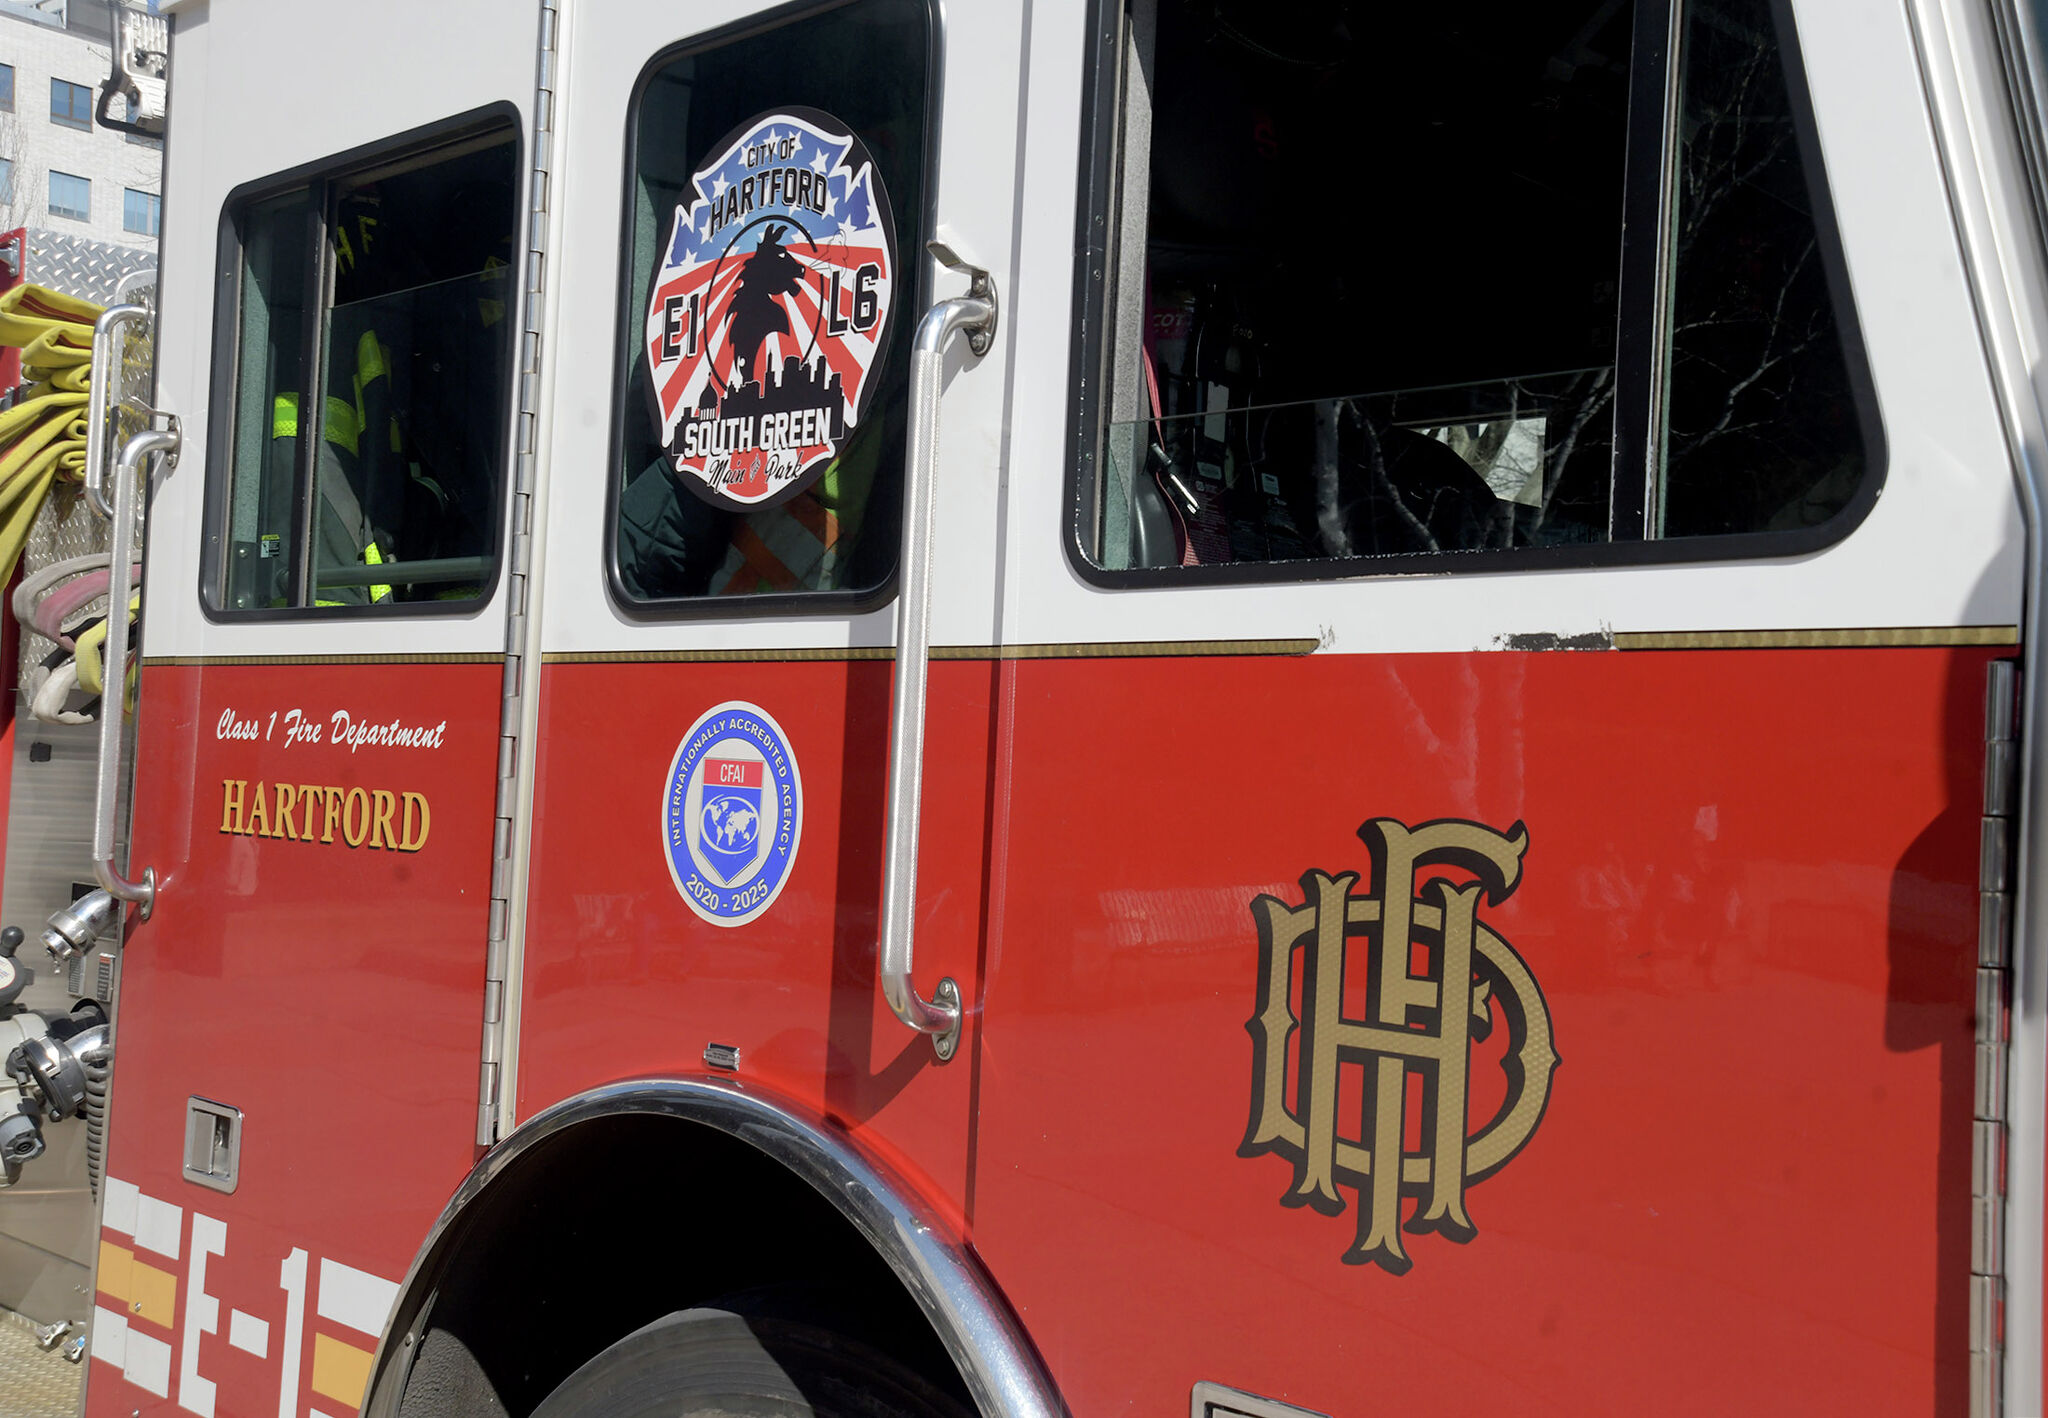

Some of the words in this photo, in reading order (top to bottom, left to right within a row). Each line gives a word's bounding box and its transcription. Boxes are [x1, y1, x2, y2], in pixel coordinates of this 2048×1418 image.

[746, 141, 777, 169] CITY
[779, 137, 797, 161] OF
[709, 167, 829, 238] HARTFORD
[828, 262, 880, 338] L6
[661, 293, 699, 361] E1
[684, 415, 754, 459] SOUTH
[759, 406, 832, 451] GREEN
[708, 458, 747, 492] Main
[764, 451, 804, 483] Park
[216, 707, 259, 741] Class
[266, 711, 278, 742] 1
[284, 708, 322, 749] Fire
[331, 709, 447, 754] Department
[671, 719, 726, 847] INTERNATIONALLY
[729, 717, 788, 779] ACCREDITED
[777, 783, 793, 858] AGENCY
[720, 763, 745, 784] CFAI
[219, 779, 431, 853] HARTFORD
[686, 873, 720, 912] 2020
[731, 878, 769, 912] 2025
